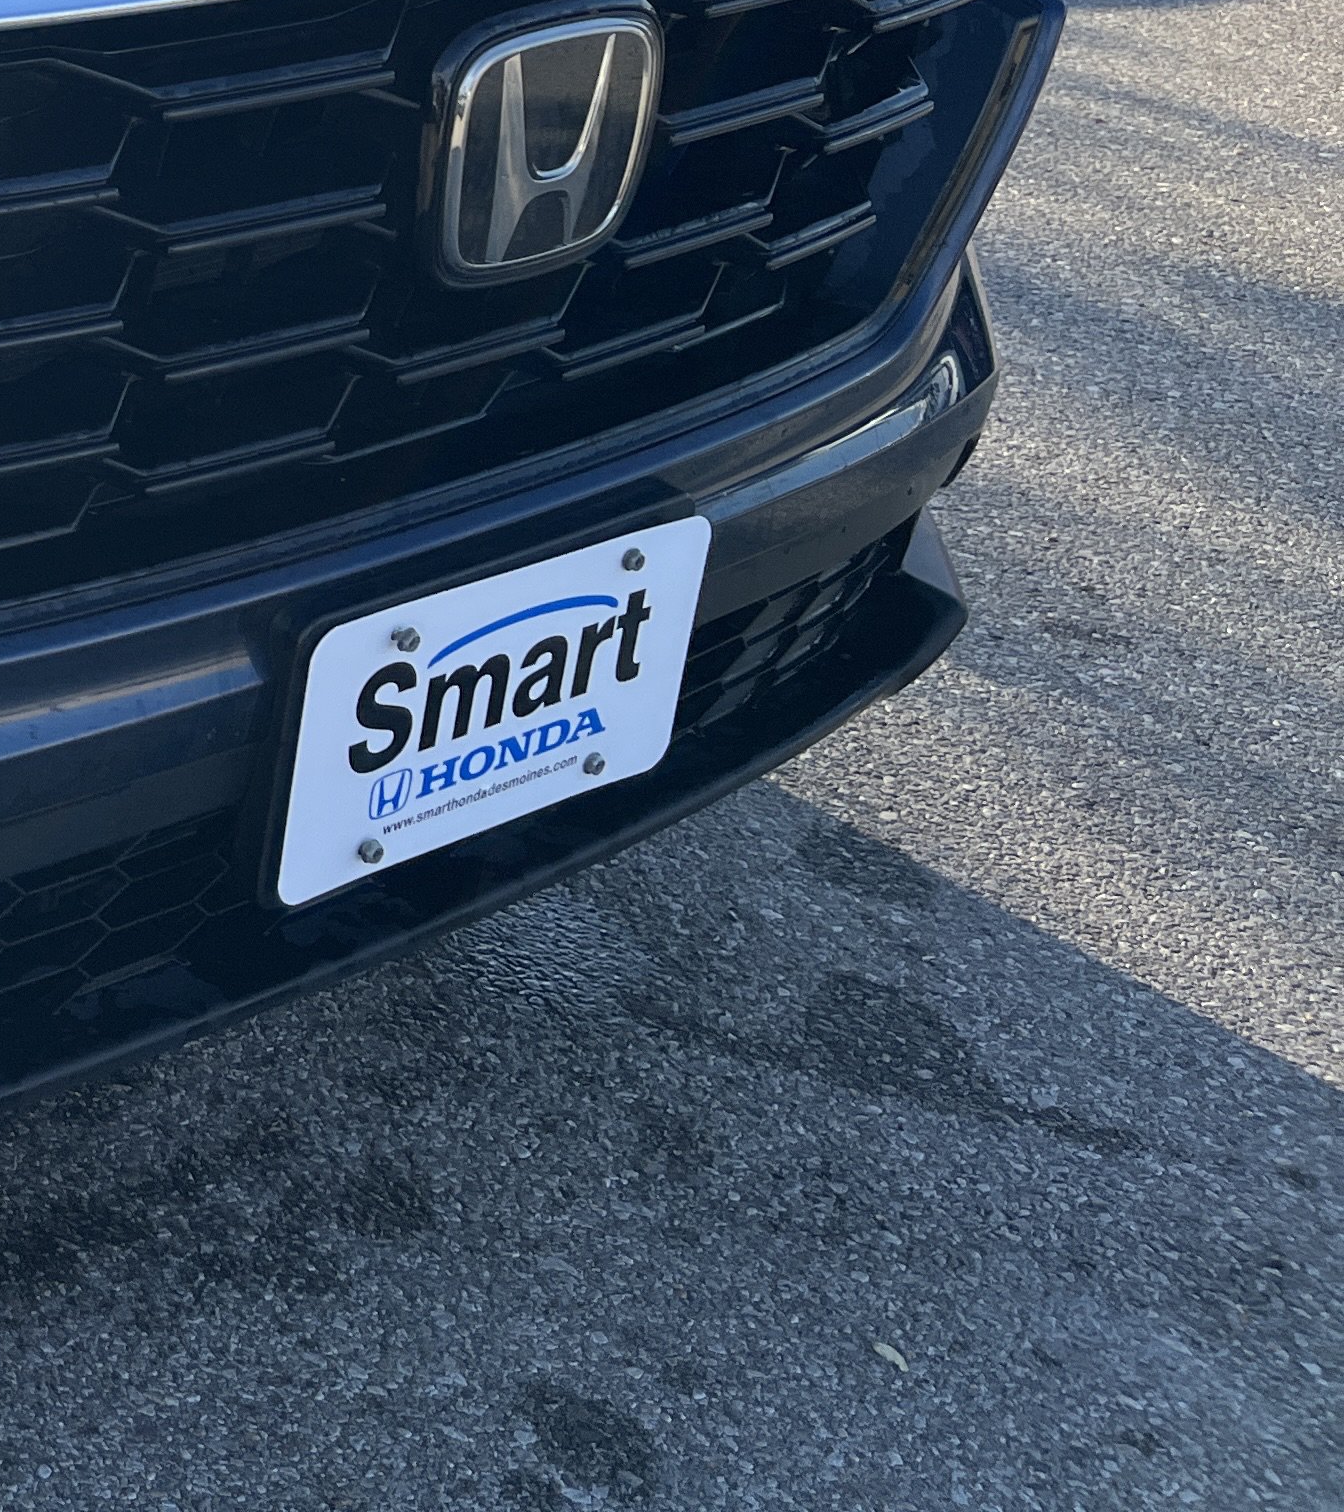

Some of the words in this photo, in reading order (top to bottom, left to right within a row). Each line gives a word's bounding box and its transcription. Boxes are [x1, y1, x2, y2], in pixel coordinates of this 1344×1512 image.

[348, 589, 652, 774] Smart
[382, 754, 578, 835] www.smarthondadesmoines.com
[416, 708, 605, 798] HONDA
